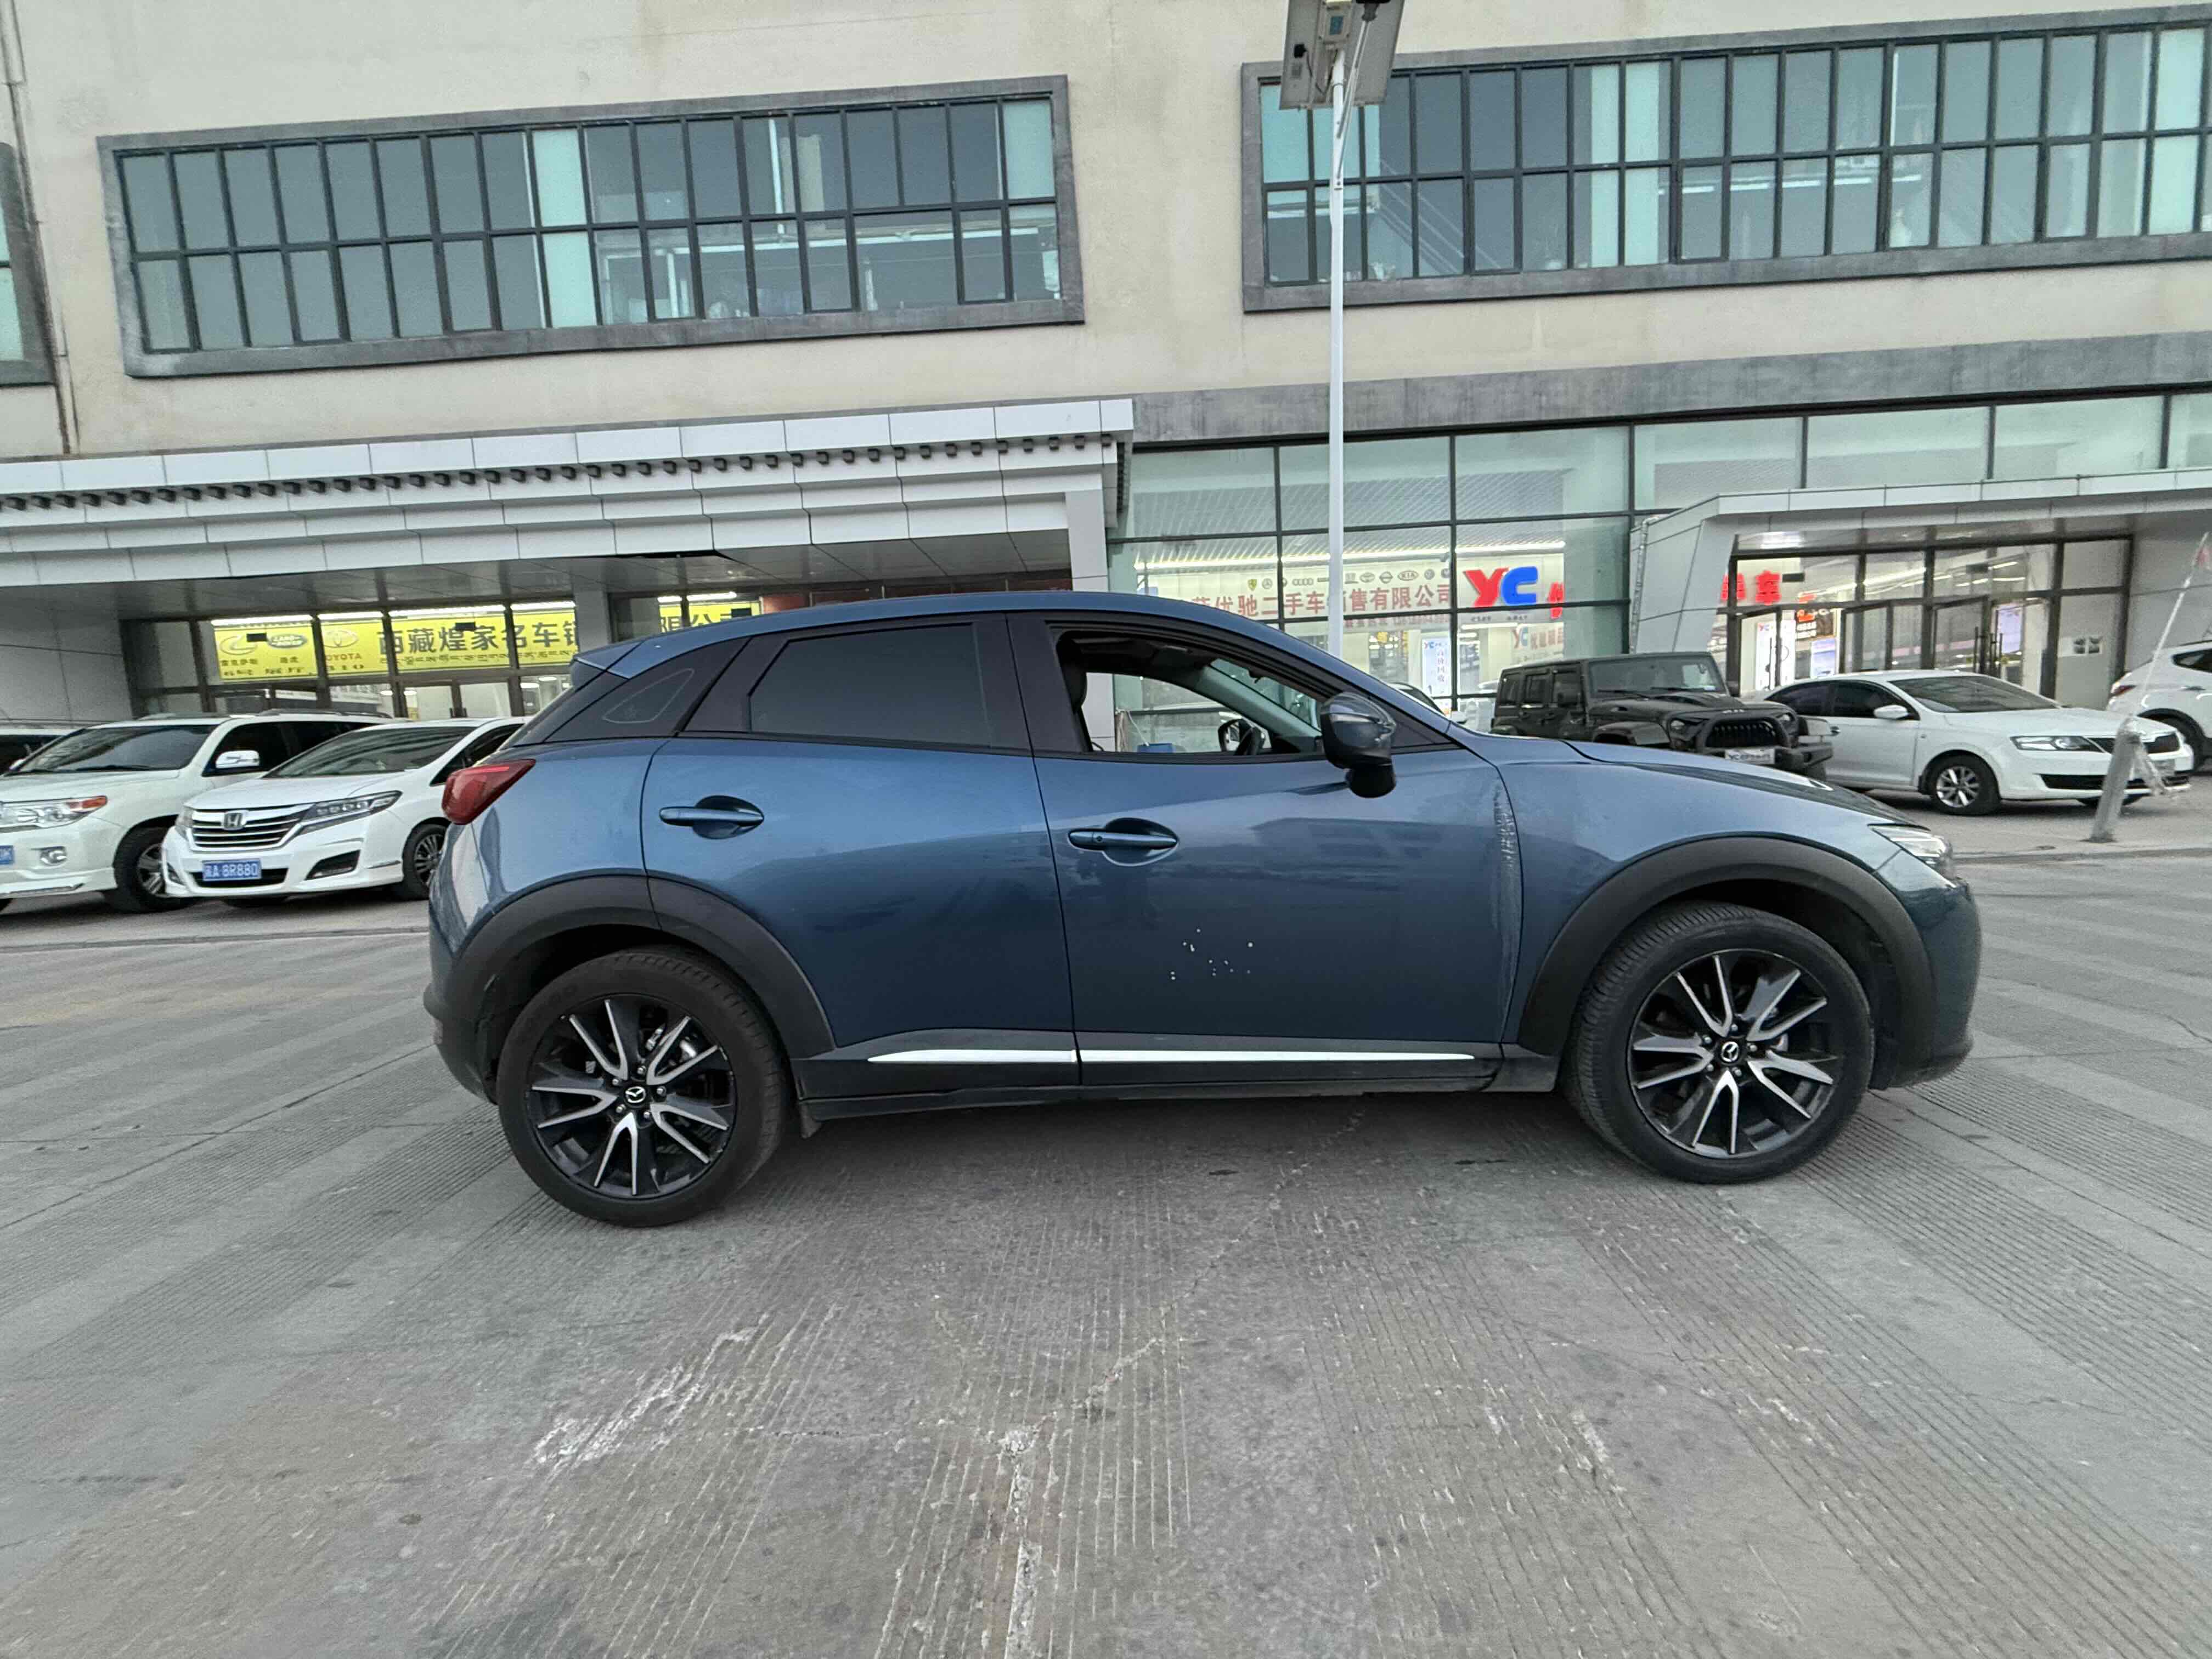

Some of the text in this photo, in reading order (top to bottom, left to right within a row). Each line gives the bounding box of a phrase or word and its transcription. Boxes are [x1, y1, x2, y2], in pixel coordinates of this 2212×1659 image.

[1193, 584, 1449, 616] 优驰二手车售有限公司
[1463, 566, 1538, 607] YC
[326, 653, 362, 662] OYOTA
